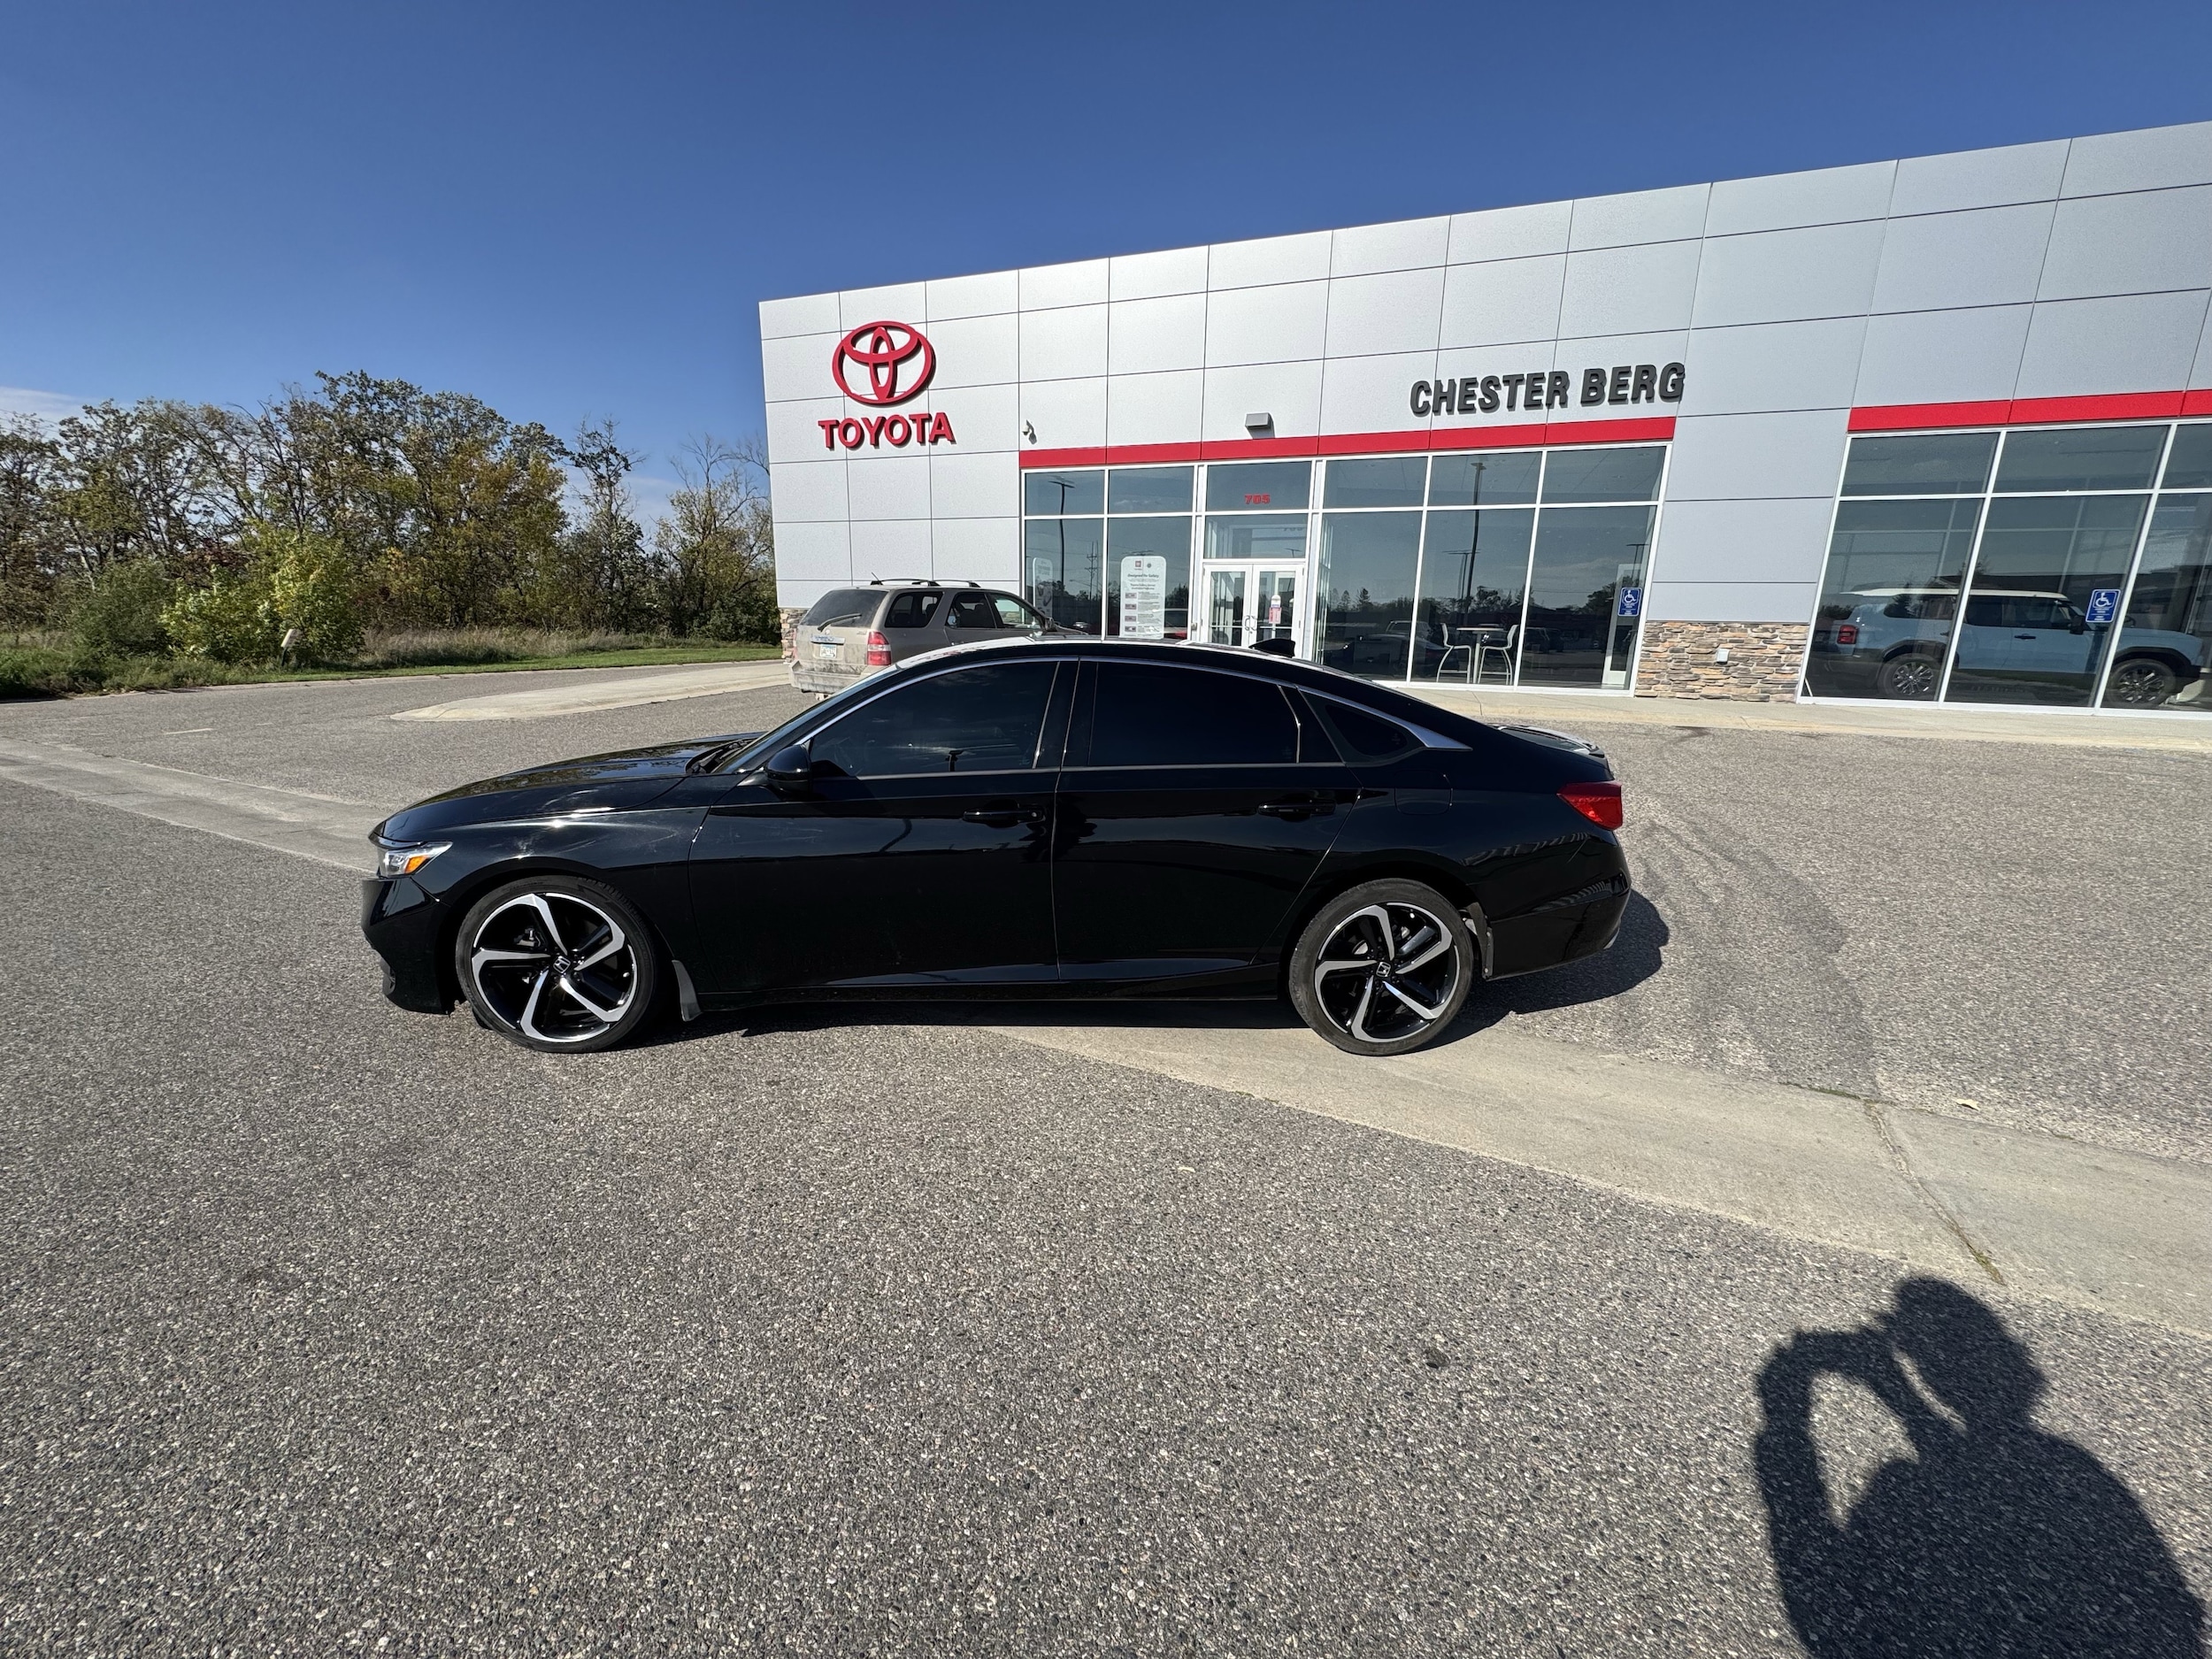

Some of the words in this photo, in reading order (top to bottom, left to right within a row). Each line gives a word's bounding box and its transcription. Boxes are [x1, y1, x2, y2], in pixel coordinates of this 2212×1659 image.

[1410, 372, 1569, 418] CHESTER
[1581, 362, 1685, 405] BERG
[818, 412, 956, 449] TOYOTA
